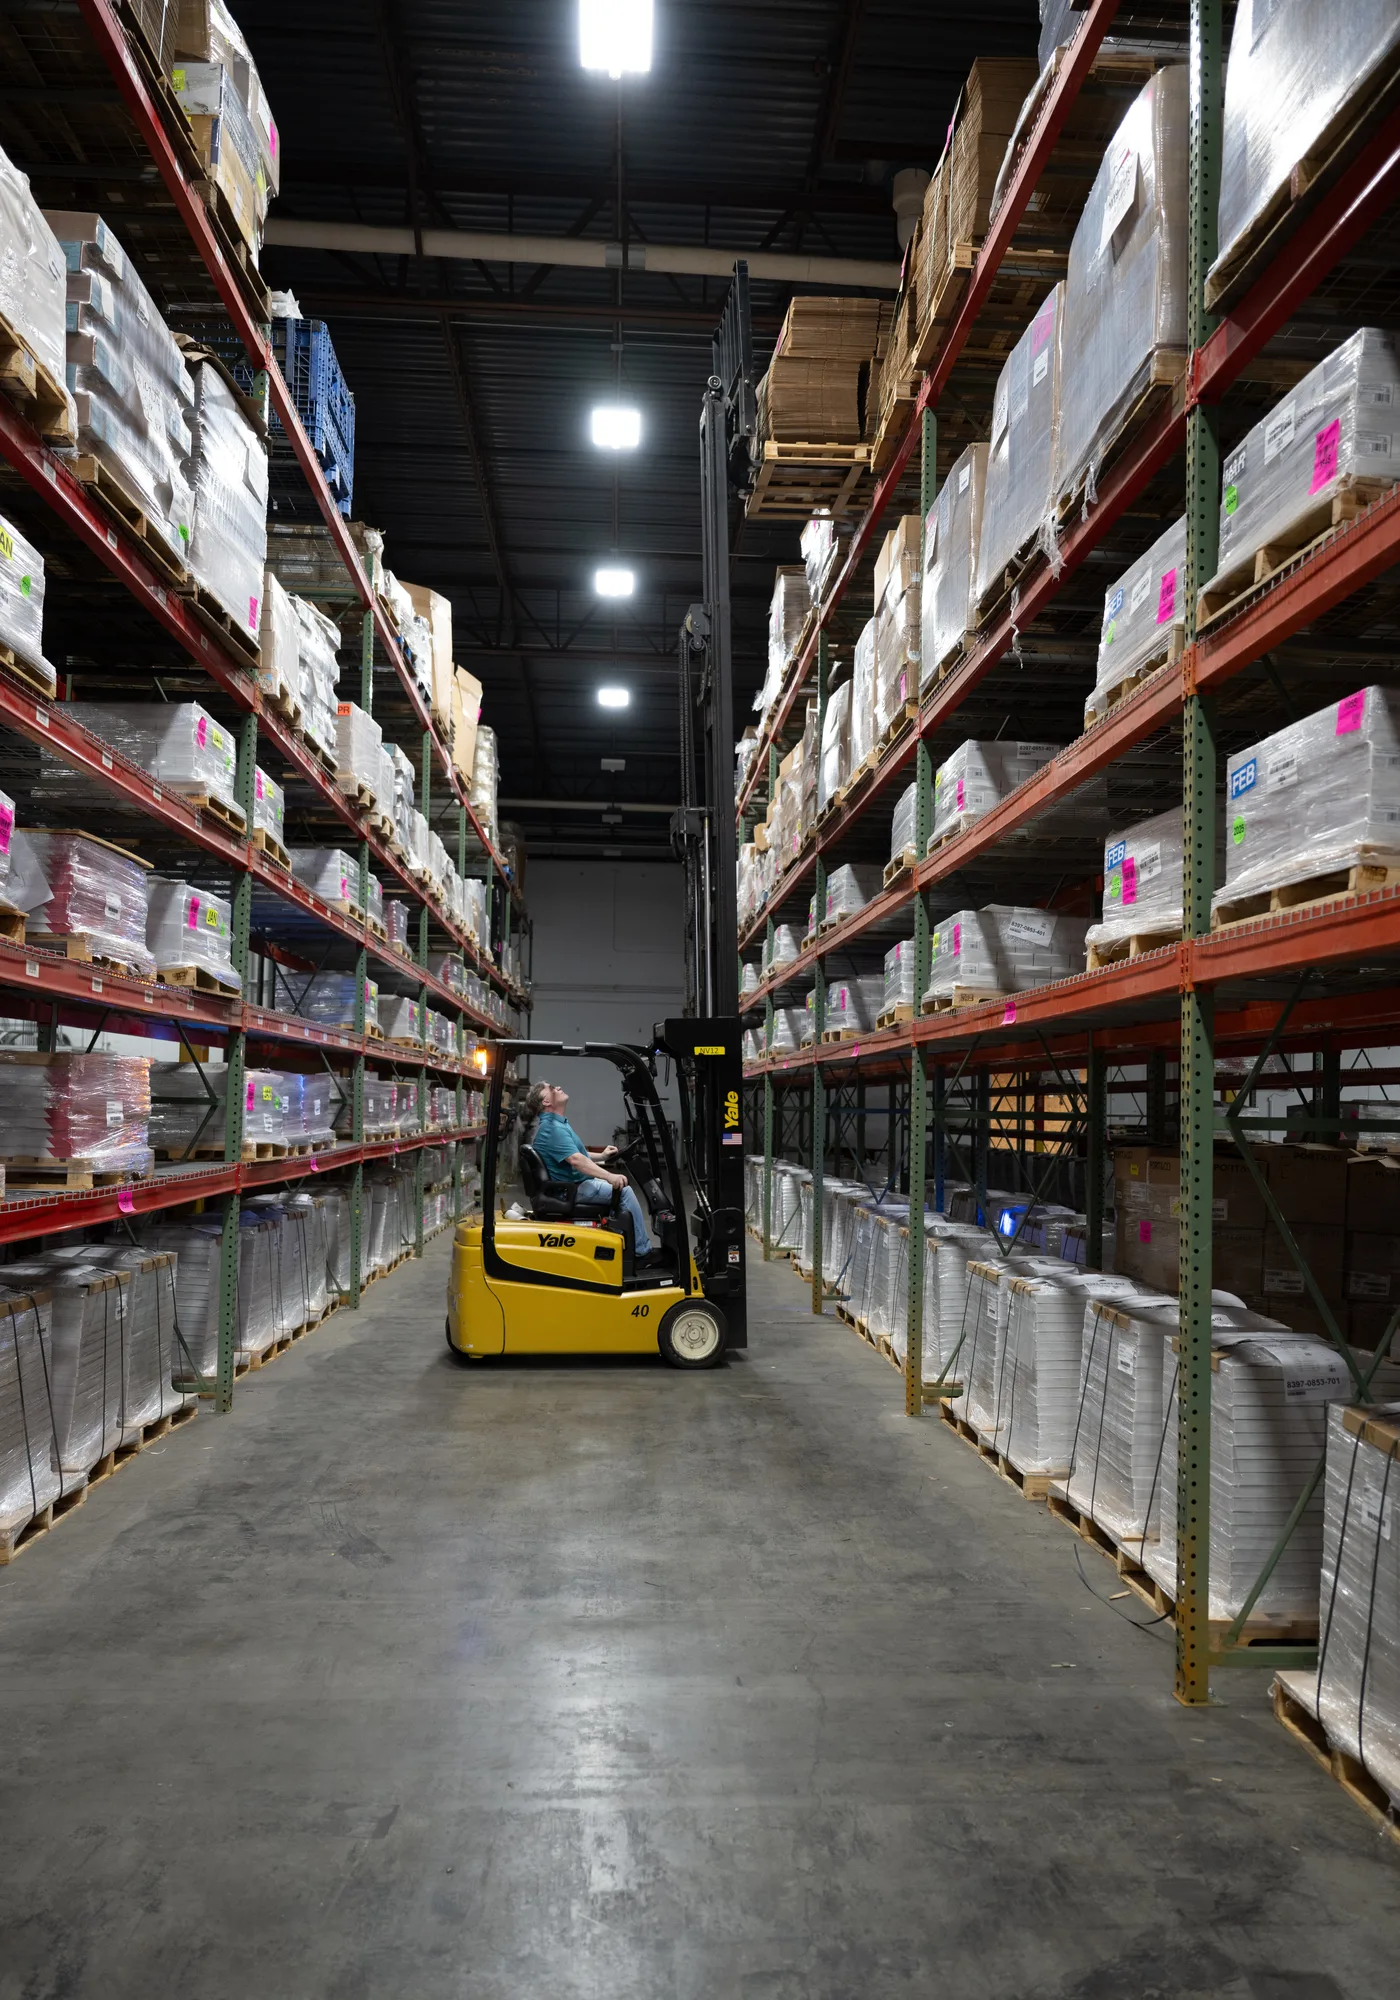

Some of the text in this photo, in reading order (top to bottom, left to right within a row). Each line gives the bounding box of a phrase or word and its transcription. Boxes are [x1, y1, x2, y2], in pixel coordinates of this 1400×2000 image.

[1232, 763, 1255, 796] FEB
[1108, 844, 1124, 868] FEB
[724, 1090, 739, 1129] Yale
[538, 1234, 576, 1247] Yale
[631, 1304, 650, 1318] 40
[1286, 1376, 1341, 1389] 8397-0853-701
